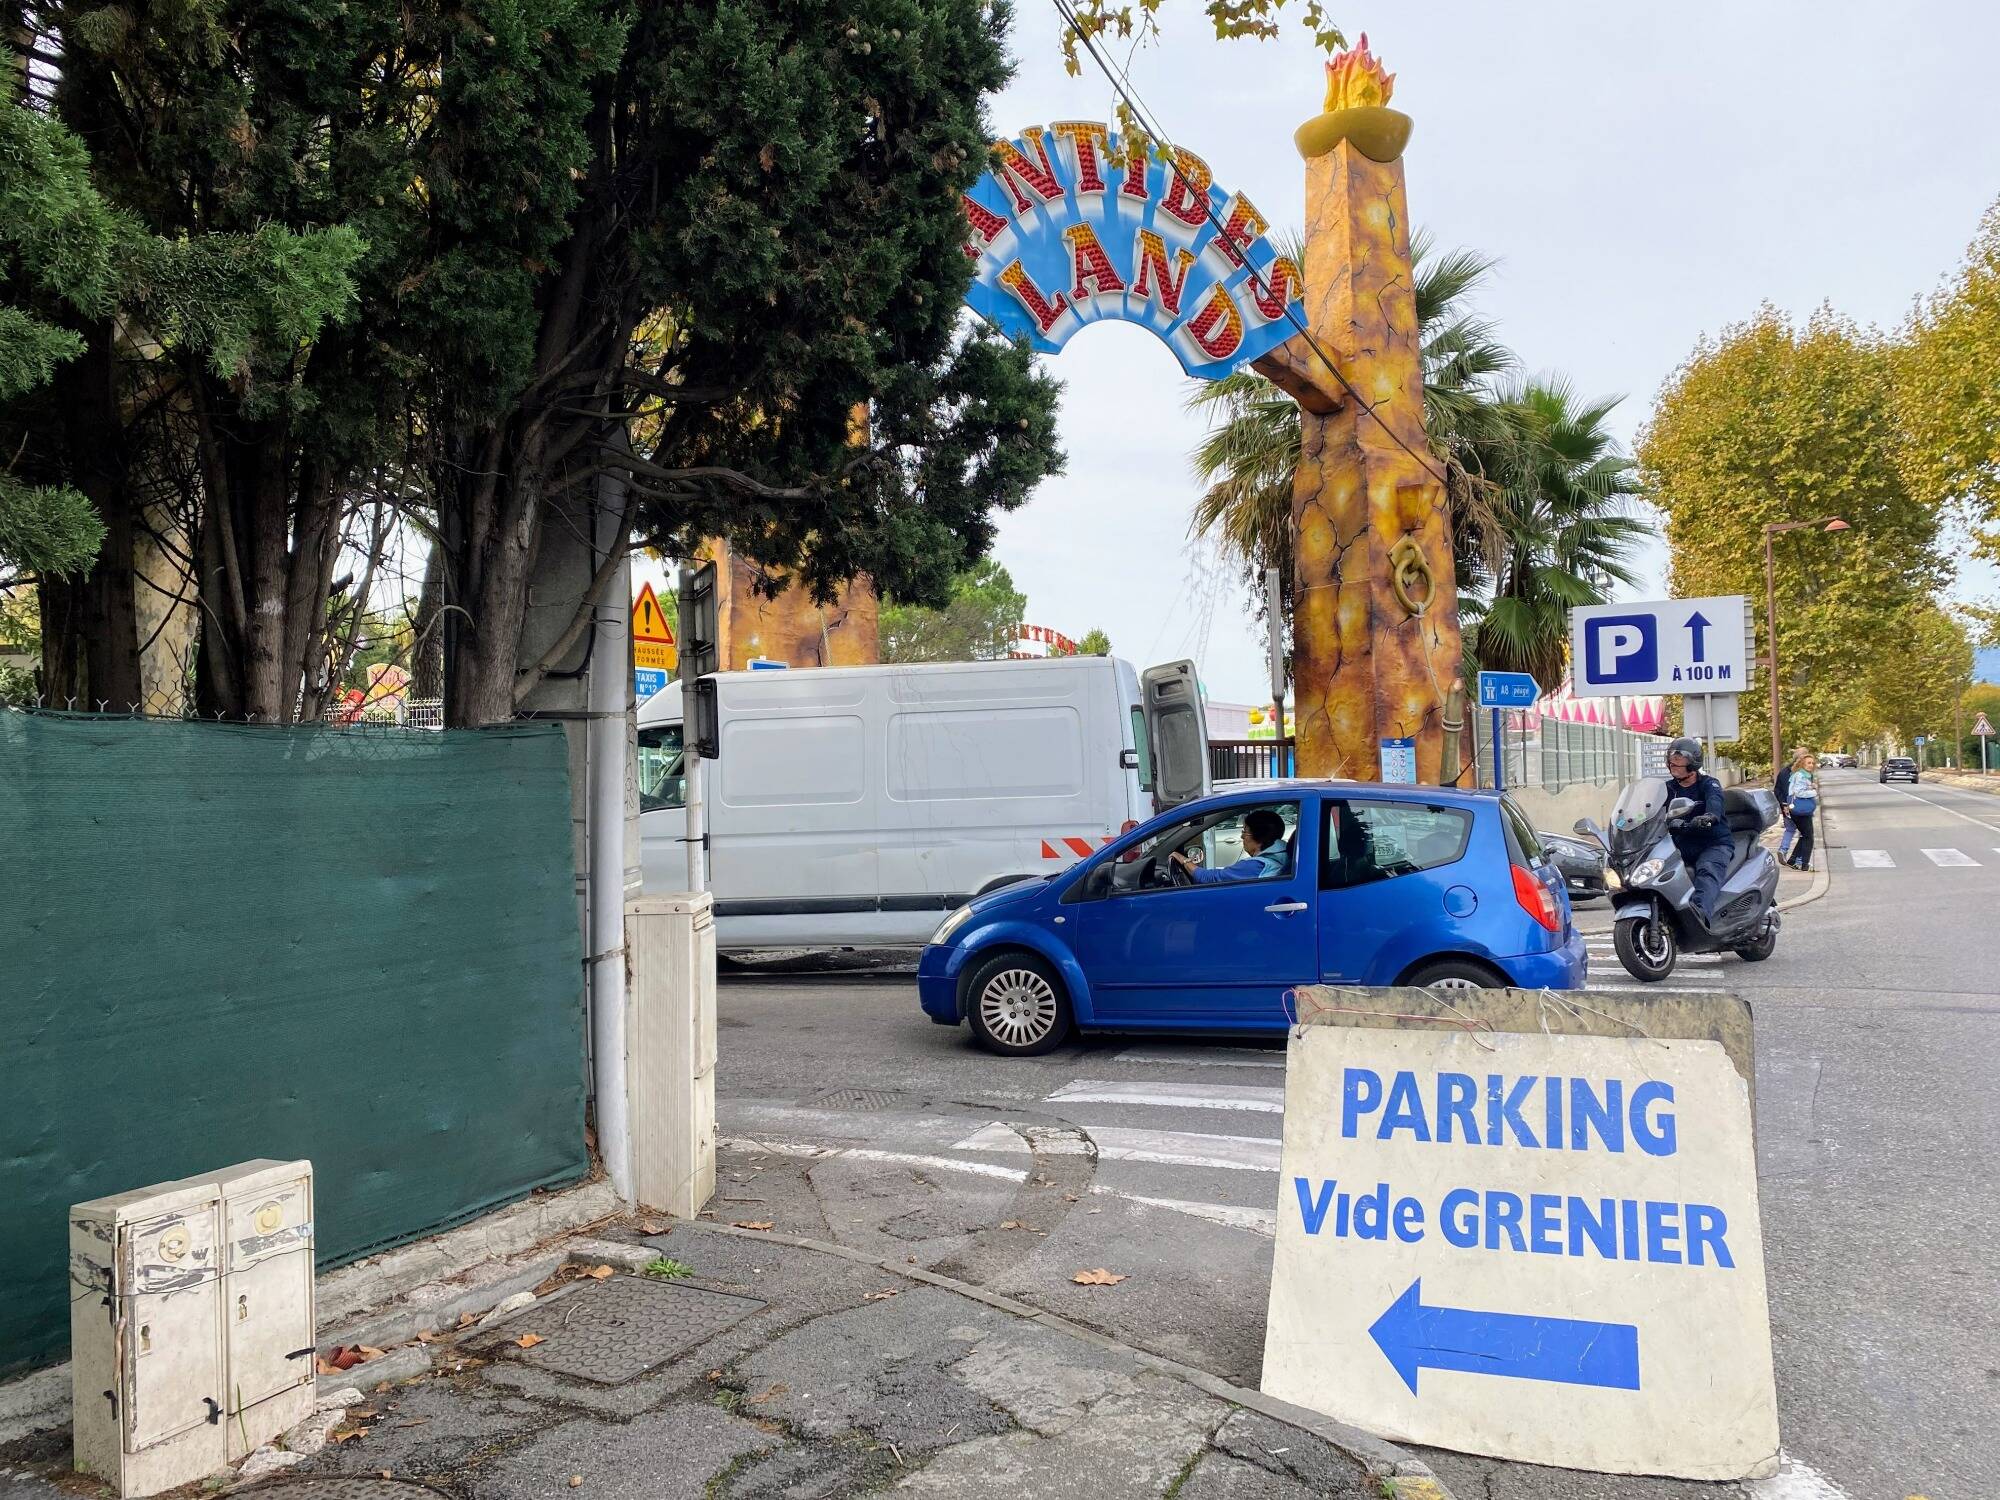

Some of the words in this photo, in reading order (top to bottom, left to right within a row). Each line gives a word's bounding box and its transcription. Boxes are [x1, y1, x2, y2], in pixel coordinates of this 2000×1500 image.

[997, 221, 1245, 362] LAND
[635, 647, 665, 656] AUSSÉE
[1598, 624, 1644, 676] P
[1672, 664, 1683, 681] À
[1686, 665, 1713, 681] 100
[1718, 664, 1731, 679] M
[637, 673, 657, 682] TAXIS
[1342, 1068, 1677, 1157] PARKING
[1294, 1177, 1425, 1243] Vide
[1440, 1189, 1733, 1268] GRENIER
